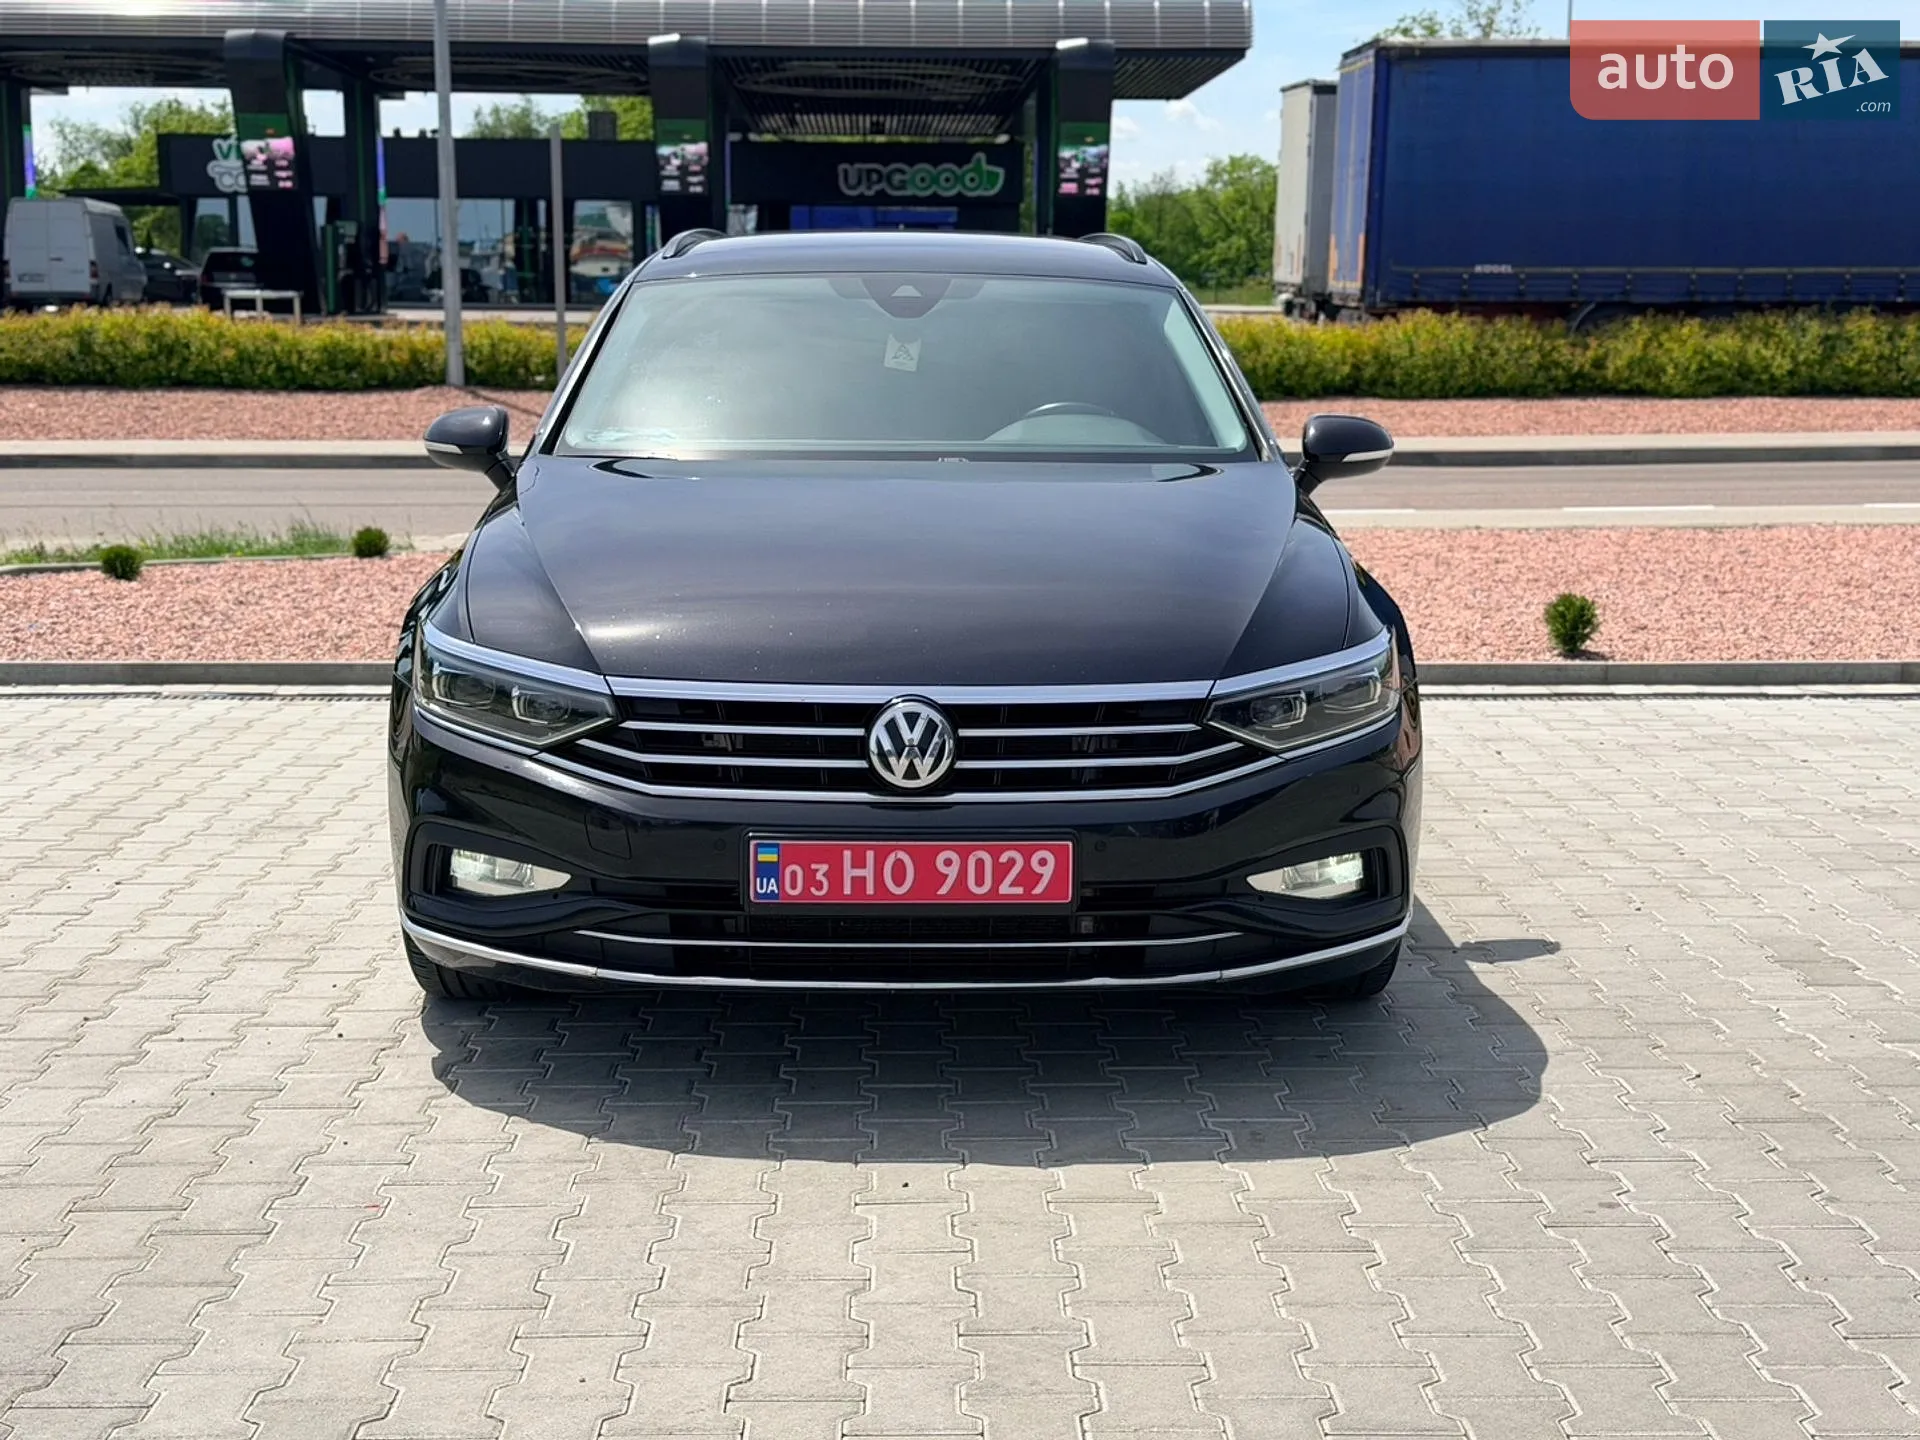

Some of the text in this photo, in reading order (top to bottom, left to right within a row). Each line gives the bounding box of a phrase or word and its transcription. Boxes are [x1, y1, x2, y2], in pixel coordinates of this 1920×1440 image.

[756, 877, 779, 893] UA
[784, 850, 1056, 896] 03 HO 9029
